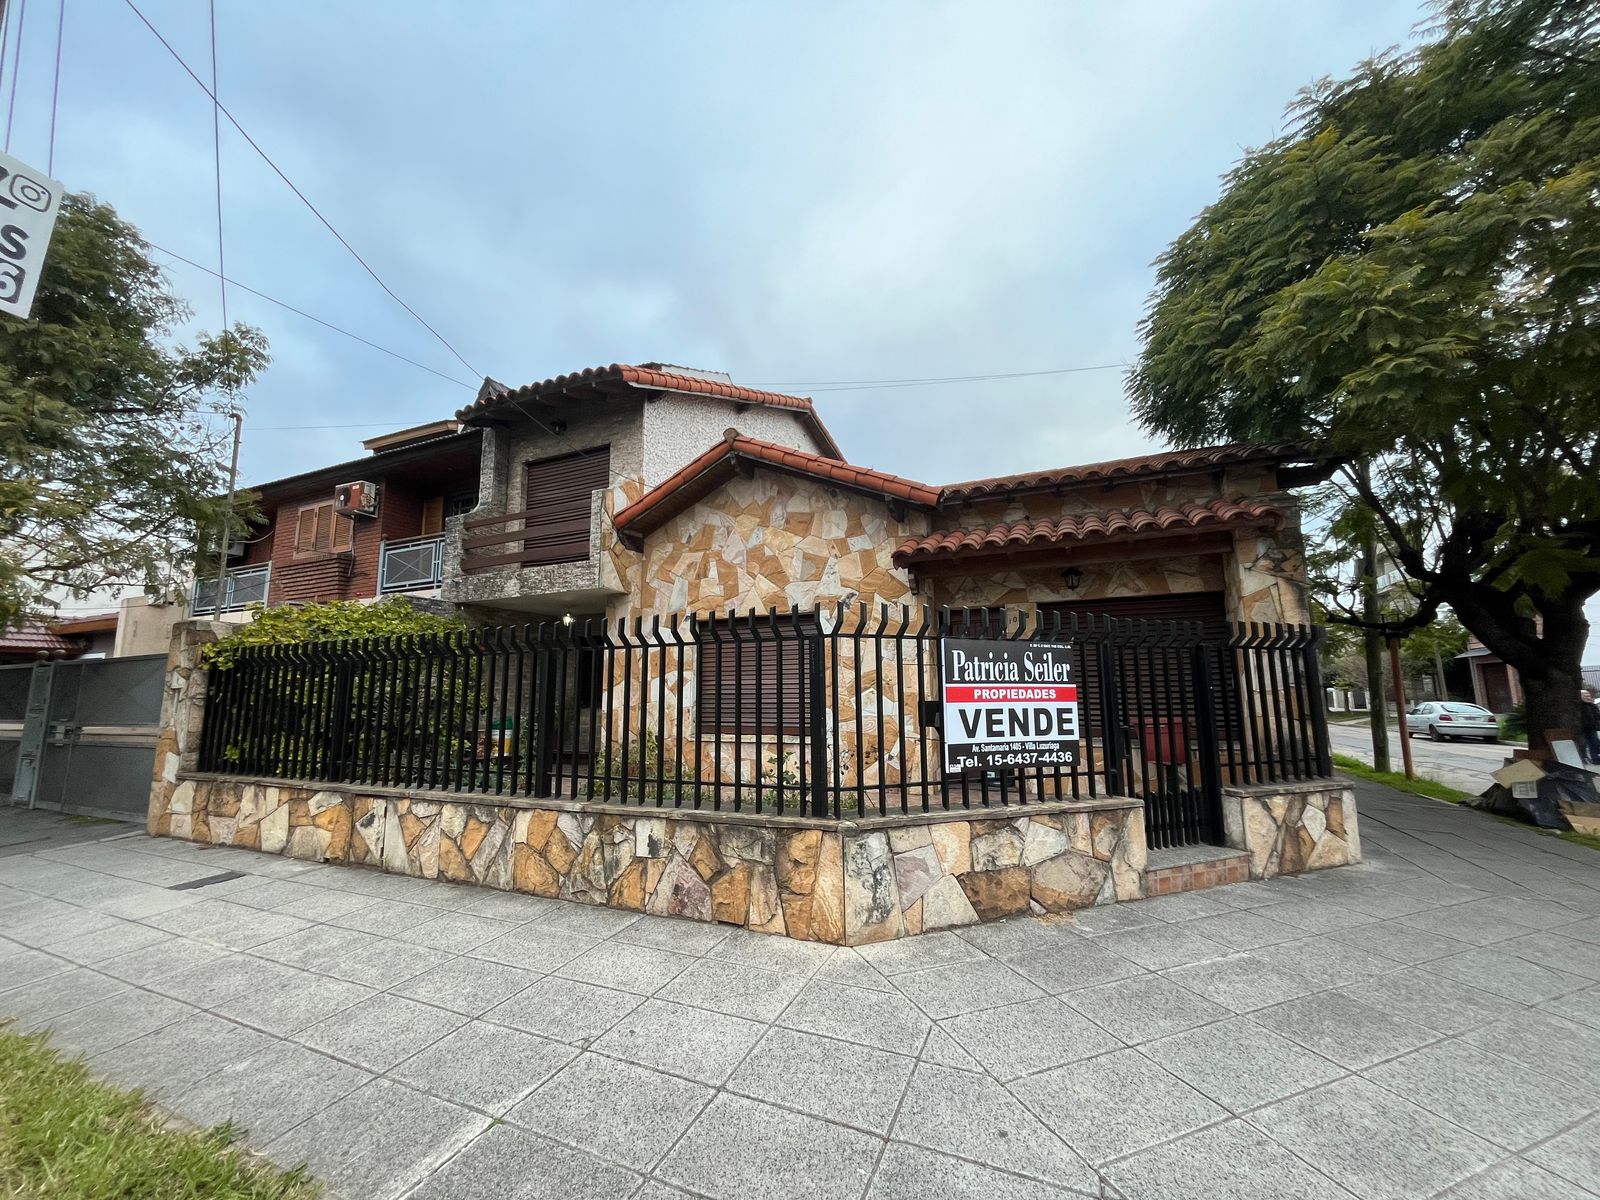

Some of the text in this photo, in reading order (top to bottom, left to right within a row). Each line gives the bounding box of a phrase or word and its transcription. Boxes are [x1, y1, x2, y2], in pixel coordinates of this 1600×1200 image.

[951, 650, 1071, 682] Patricia Seiler
[973, 689, 1056, 700] PROPIEDADES
[958, 707, 1075, 739] VENDE
[972, 744, 981, 753] Av.
[957, 755, 982, 768] Tel.
[986, 751, 1073, 766] 15-6437-4436
